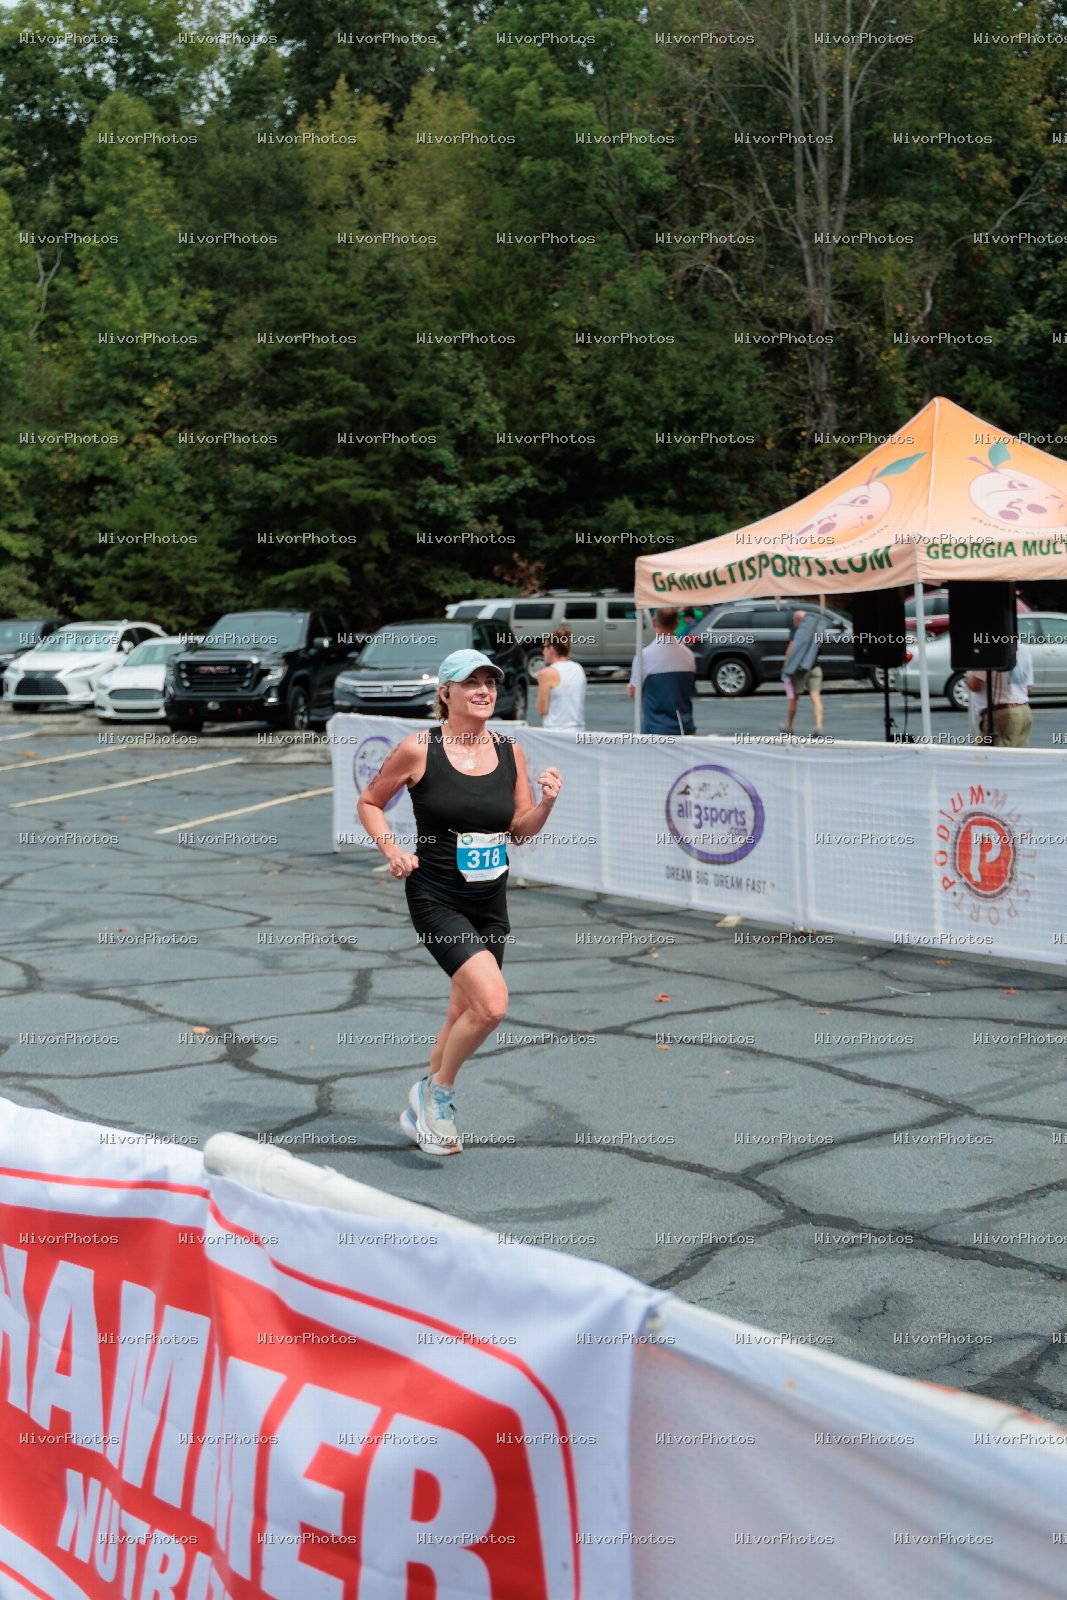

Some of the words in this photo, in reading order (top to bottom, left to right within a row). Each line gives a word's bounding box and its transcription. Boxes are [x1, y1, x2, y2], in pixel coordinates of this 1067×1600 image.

[926, 541, 1017, 560] GEORGIA
[1023, 539, 1067, 556] MUL
[934, 784, 984, 891] PODIUM
[467, 848, 500, 868] 318
[665, 865, 692, 882] DREAM
[714, 873, 743, 890] DREAM
